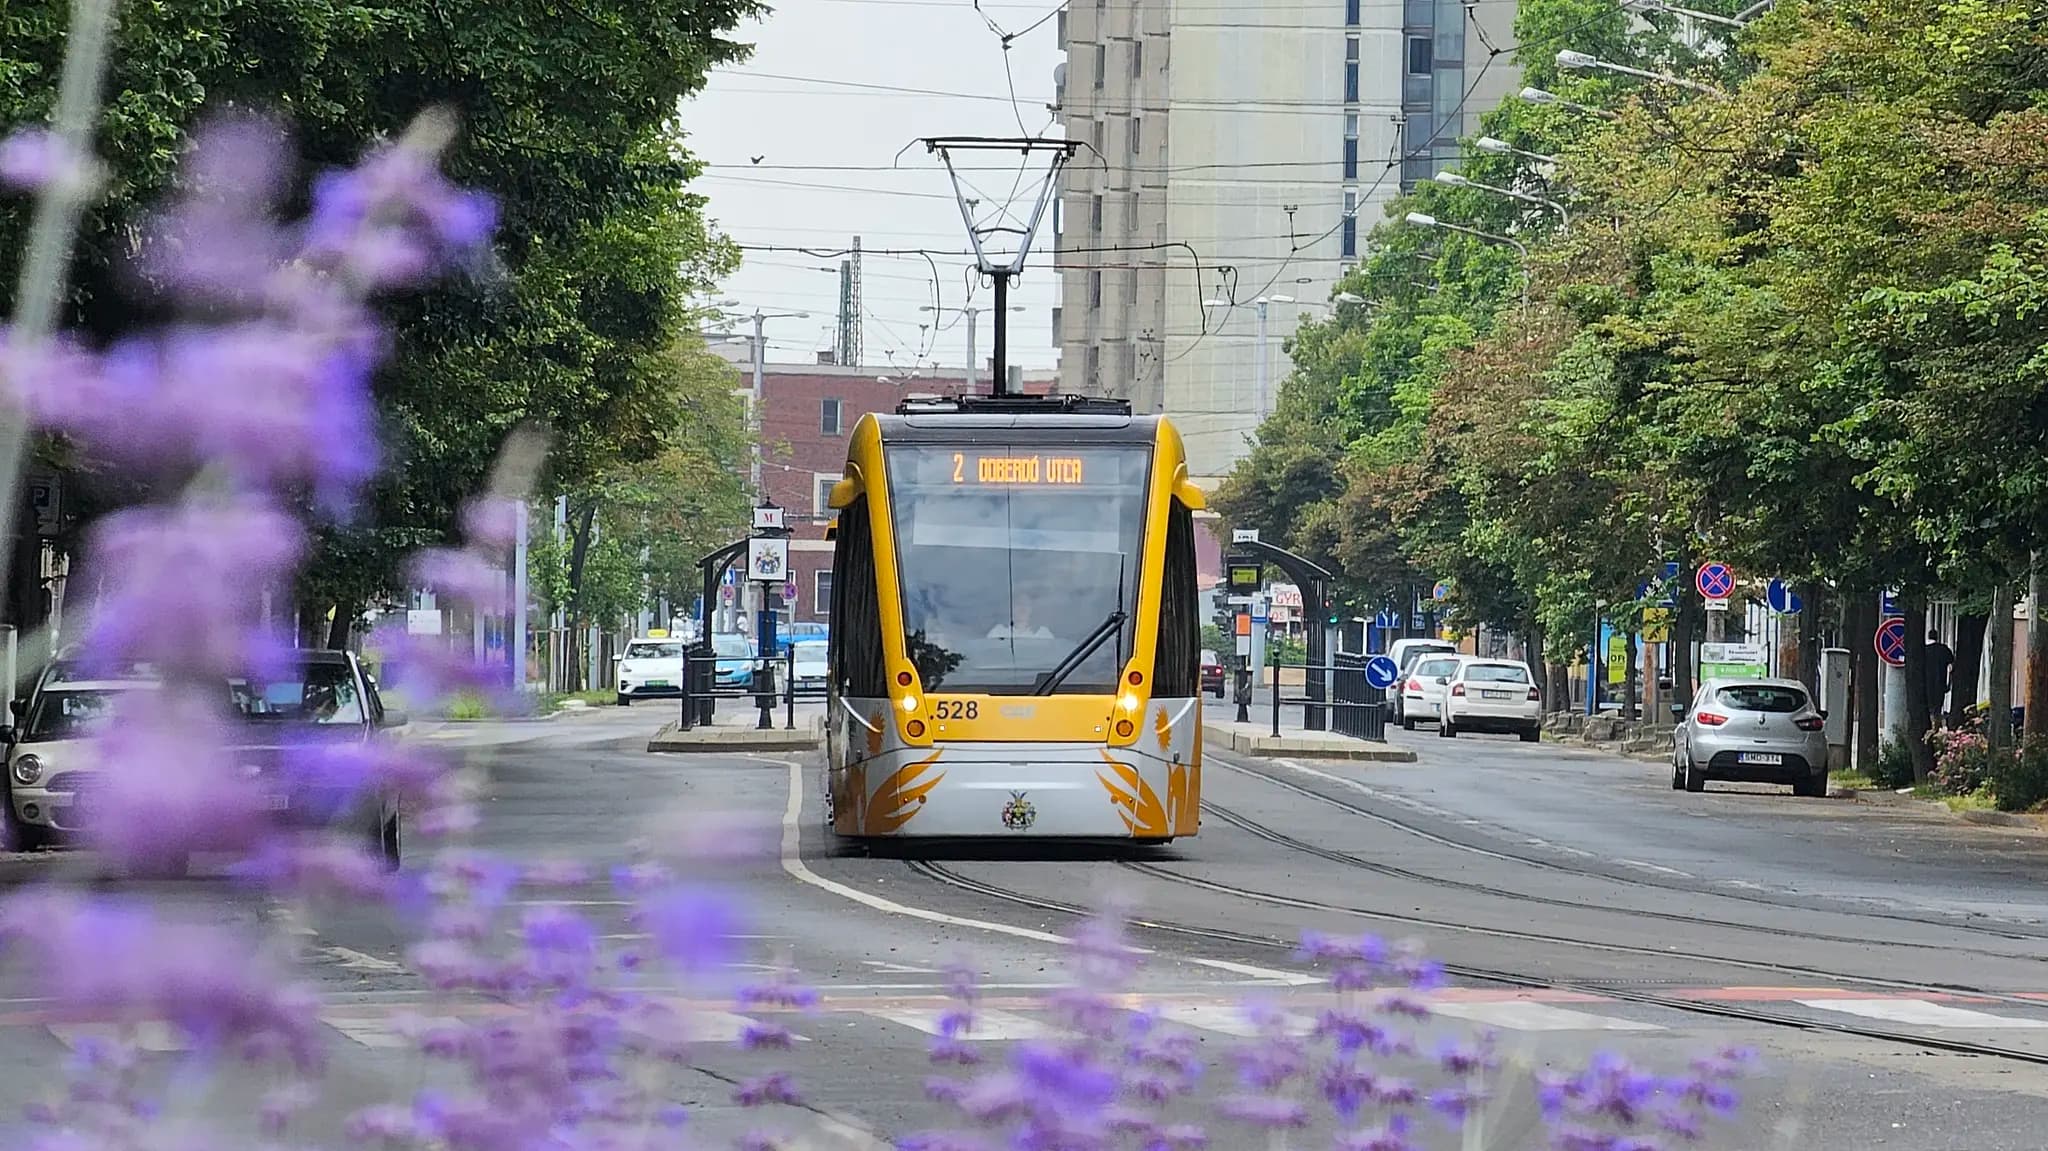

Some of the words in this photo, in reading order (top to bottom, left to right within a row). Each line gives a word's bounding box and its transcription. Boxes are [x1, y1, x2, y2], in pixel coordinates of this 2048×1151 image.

[953, 453, 964, 482] 2
[978, 455, 1039, 482] DOBERDÓ
[1046, 458, 1082, 483] UTCA
[763, 512, 773, 523] M
[936, 700, 978, 720] 528
